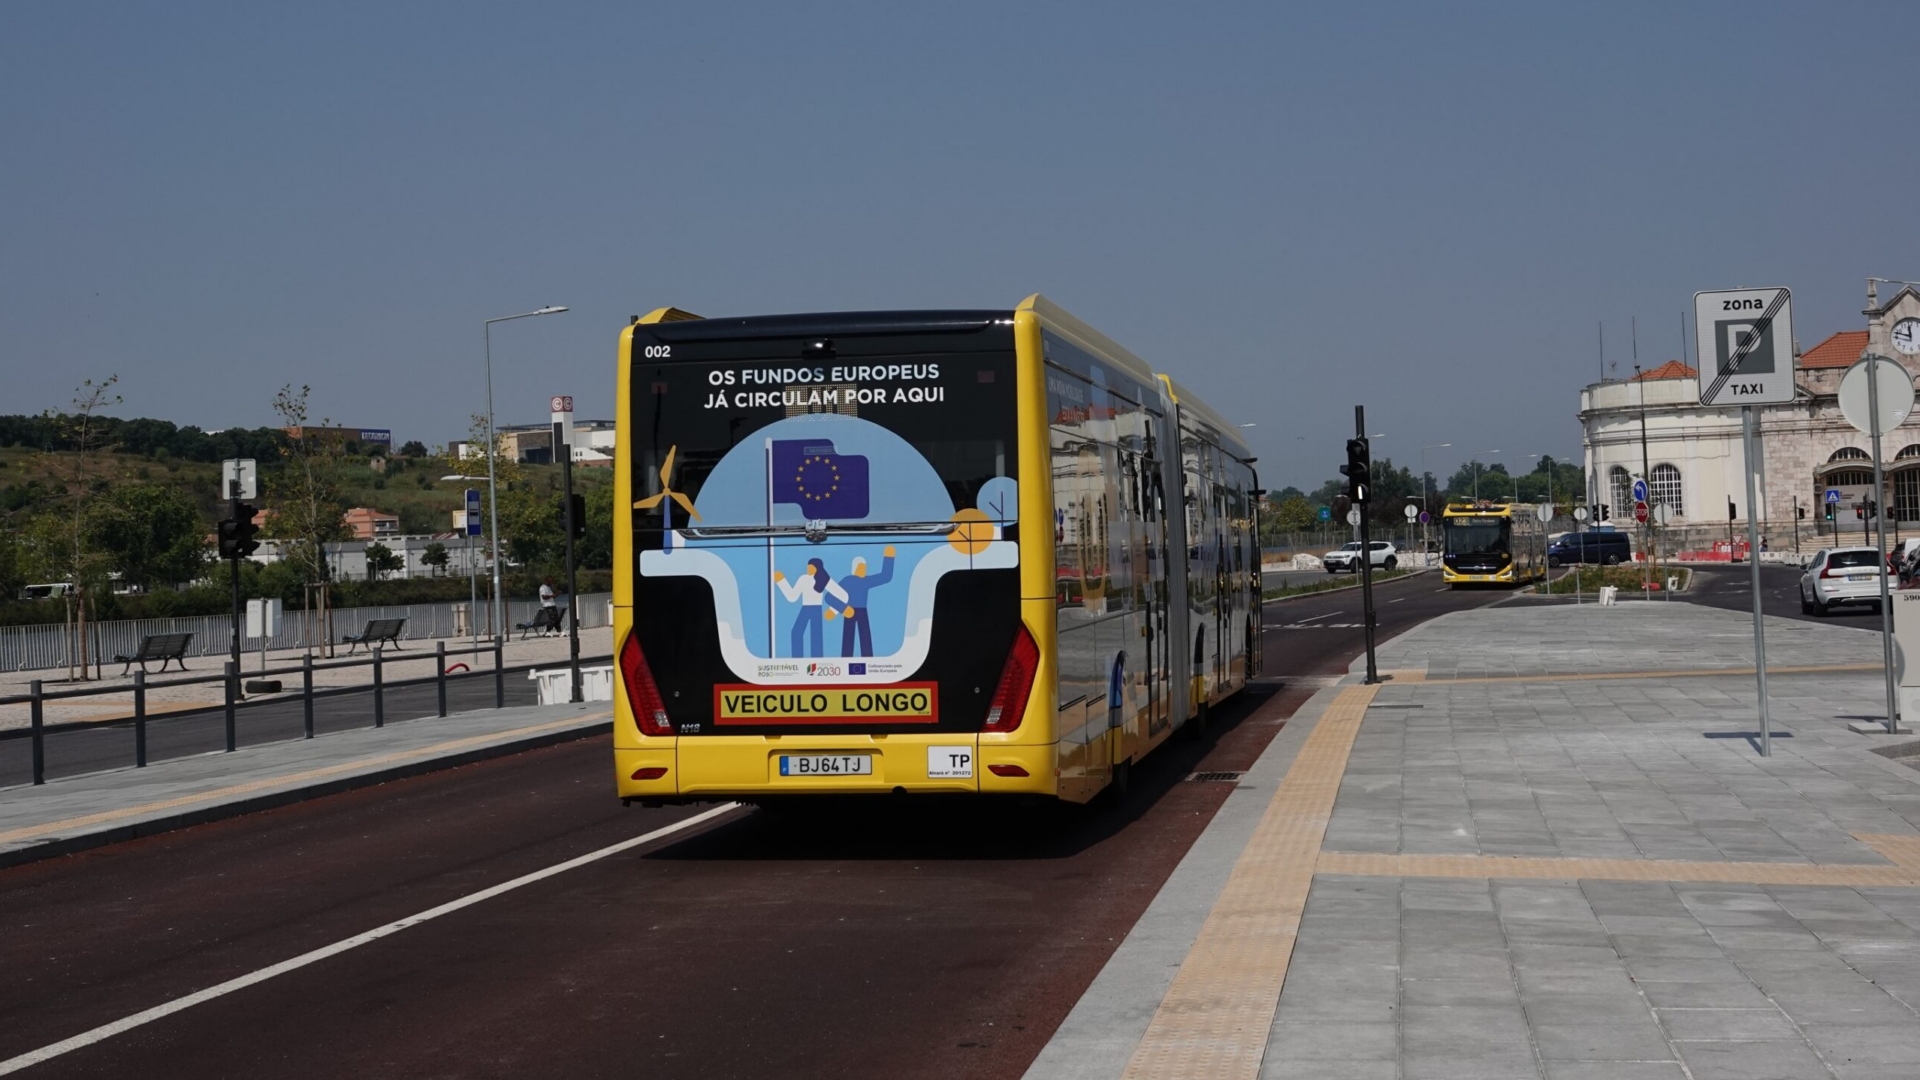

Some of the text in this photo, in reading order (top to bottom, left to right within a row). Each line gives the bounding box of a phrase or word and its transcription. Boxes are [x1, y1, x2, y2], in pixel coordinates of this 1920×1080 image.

[1723, 299, 1764, 311] zona
[644, 345, 671, 358] 002
[708, 364, 940, 385] OS FUNDOS EUROPEUS
[1731, 383, 1763, 395] TAXI
[703, 387, 945, 408] JÁ CIRCULAM POR AQUI
[1635, 508, 1648, 517] STOP
[817, 666, 841, 676] 2030
[724, 692, 928, 714] VEICULO LONGO
[948, 754, 970, 768] TP
